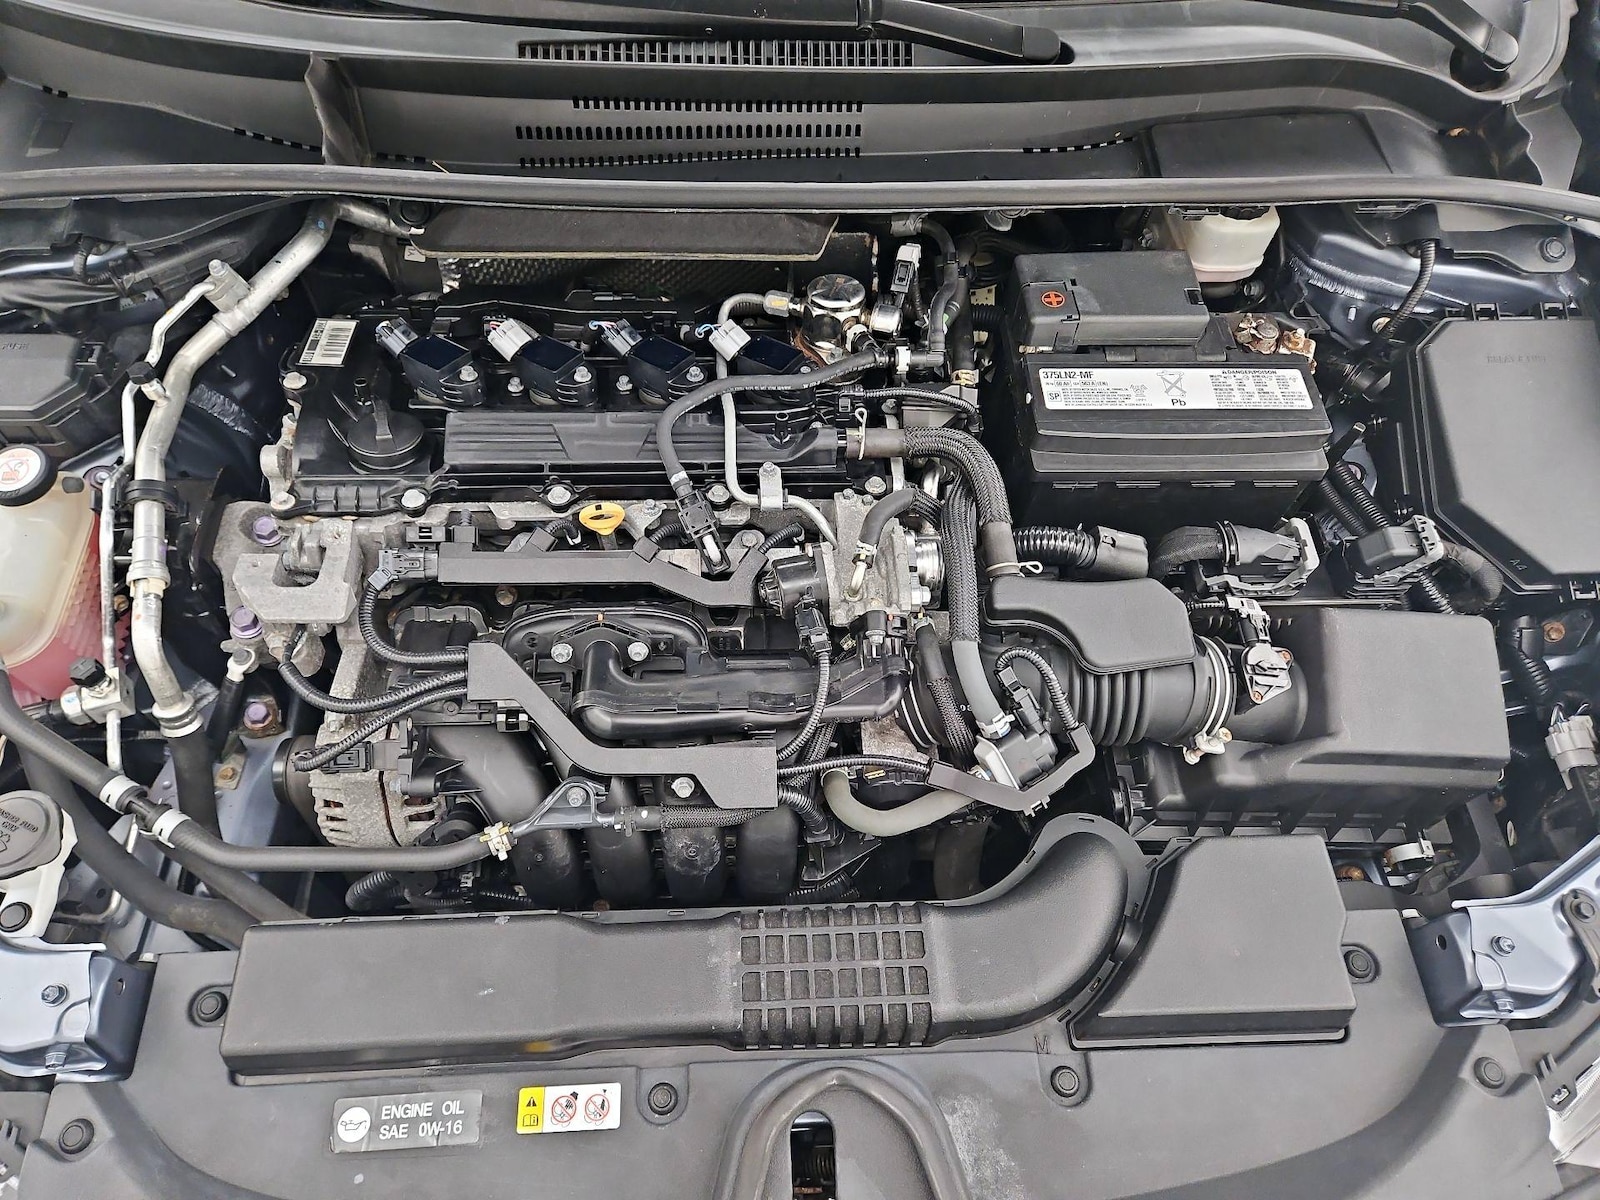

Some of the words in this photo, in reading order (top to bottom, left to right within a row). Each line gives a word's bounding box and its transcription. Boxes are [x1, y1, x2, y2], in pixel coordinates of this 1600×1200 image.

[1042, 371, 1094, 380] 375LN2-MF
[1049, 393, 1060, 401] SP
[1171, 398, 1187, 407] Pb
[381, 1102, 433, 1119] ENGINE
[442, 1100, 464, 1115] OIL
[379, 1123, 409, 1140] SAE
[418, 1120, 463, 1137] 0W-16
